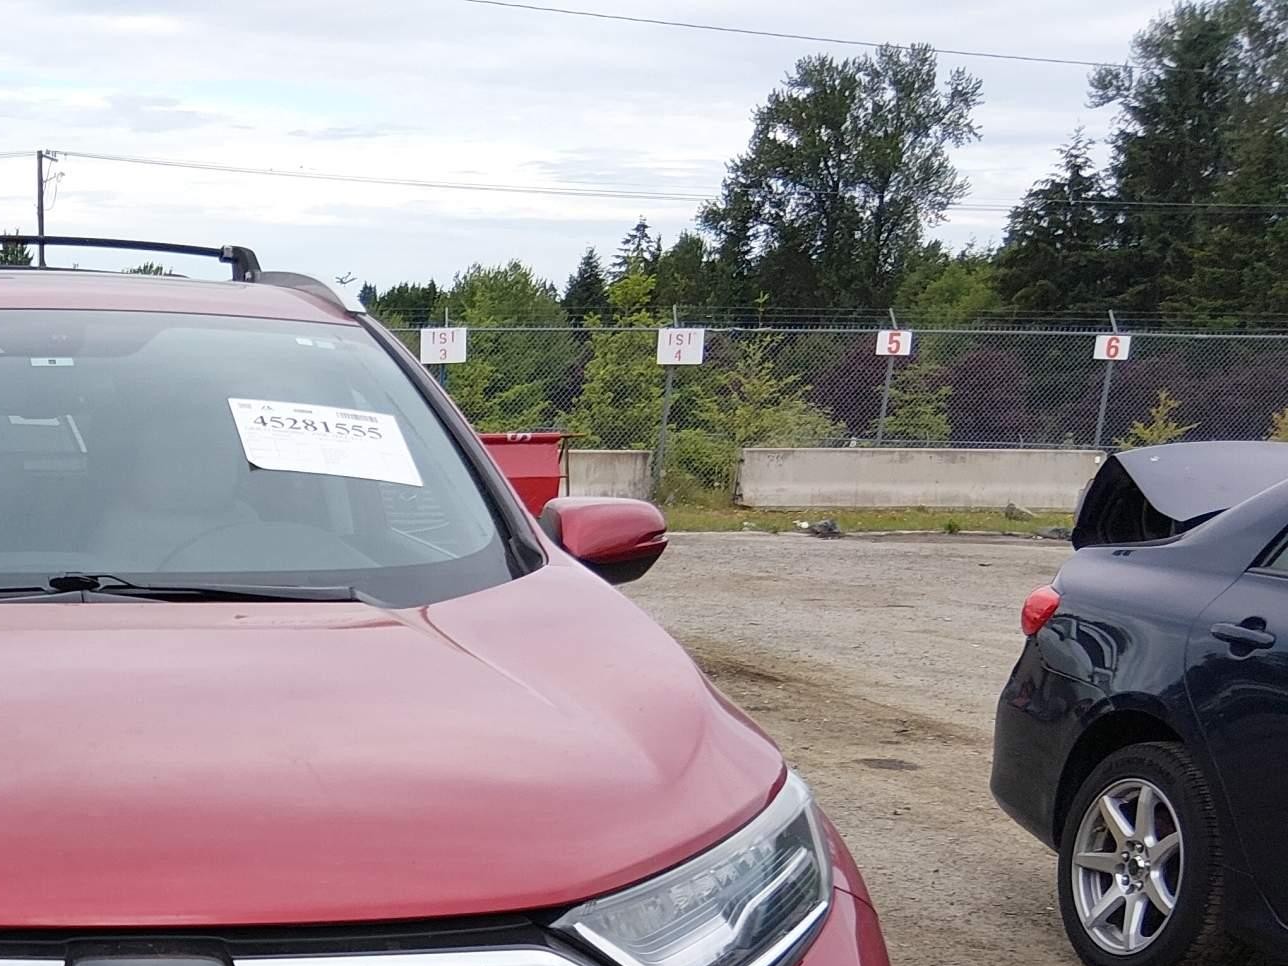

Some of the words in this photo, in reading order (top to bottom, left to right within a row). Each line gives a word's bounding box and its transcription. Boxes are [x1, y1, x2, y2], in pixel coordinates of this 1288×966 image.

[887, 332, 901, 354] 5
[1106, 336, 1120, 359] 6
[439, 348, 447, 361] 3
[674, 349, 682, 362] 4
[253, 415, 383, 439] 45281555
